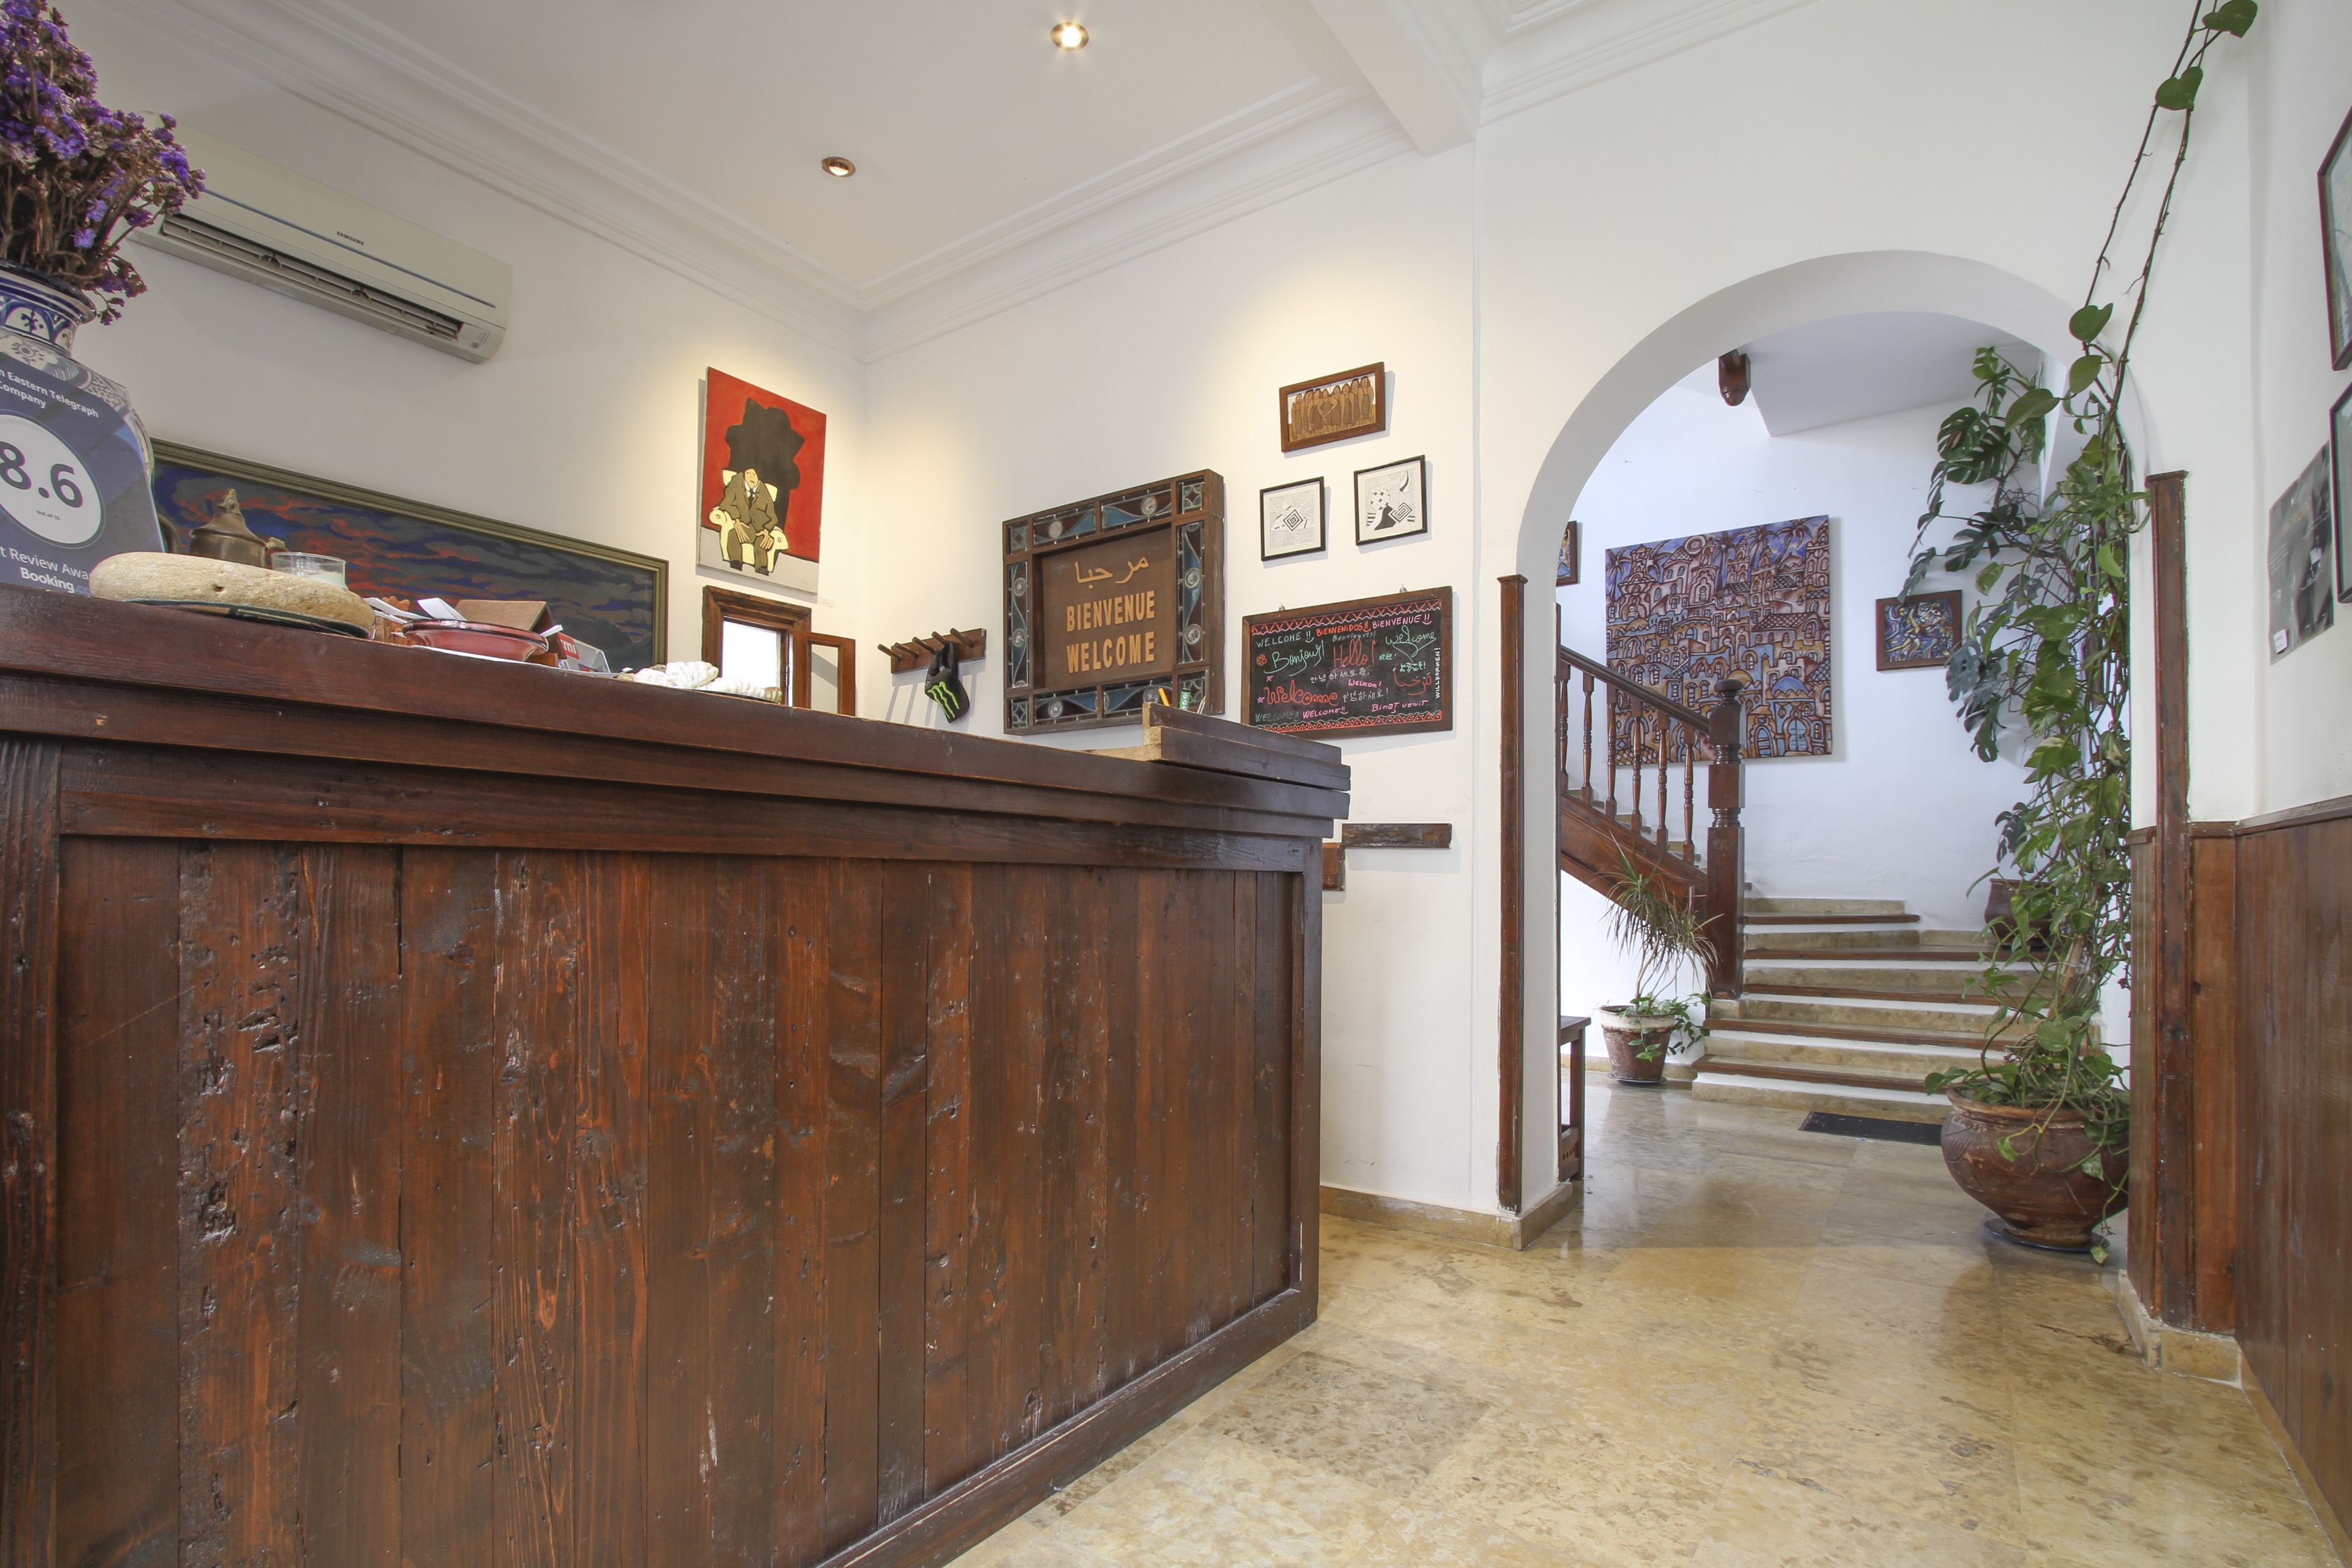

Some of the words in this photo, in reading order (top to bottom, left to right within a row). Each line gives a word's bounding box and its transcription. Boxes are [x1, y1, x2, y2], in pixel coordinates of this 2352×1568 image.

[336, 230, 364, 246] SAMSUNG
[7, 371, 48, 396] Eastern
[49, 389, 99, 418] Telegraph
[0, 441, 83, 508] 8.6
[9, 548, 58, 571] Review
[62, 563, 91, 580] Awa
[20, 567, 91, 595] Booking.co
[1073, 556, 1150, 590] مرحبا
[1066, 590, 1155, 632] BIENVENUE
[1066, 631, 1155, 674] WELCOME
[1264, 679, 1339, 706] Welcome
